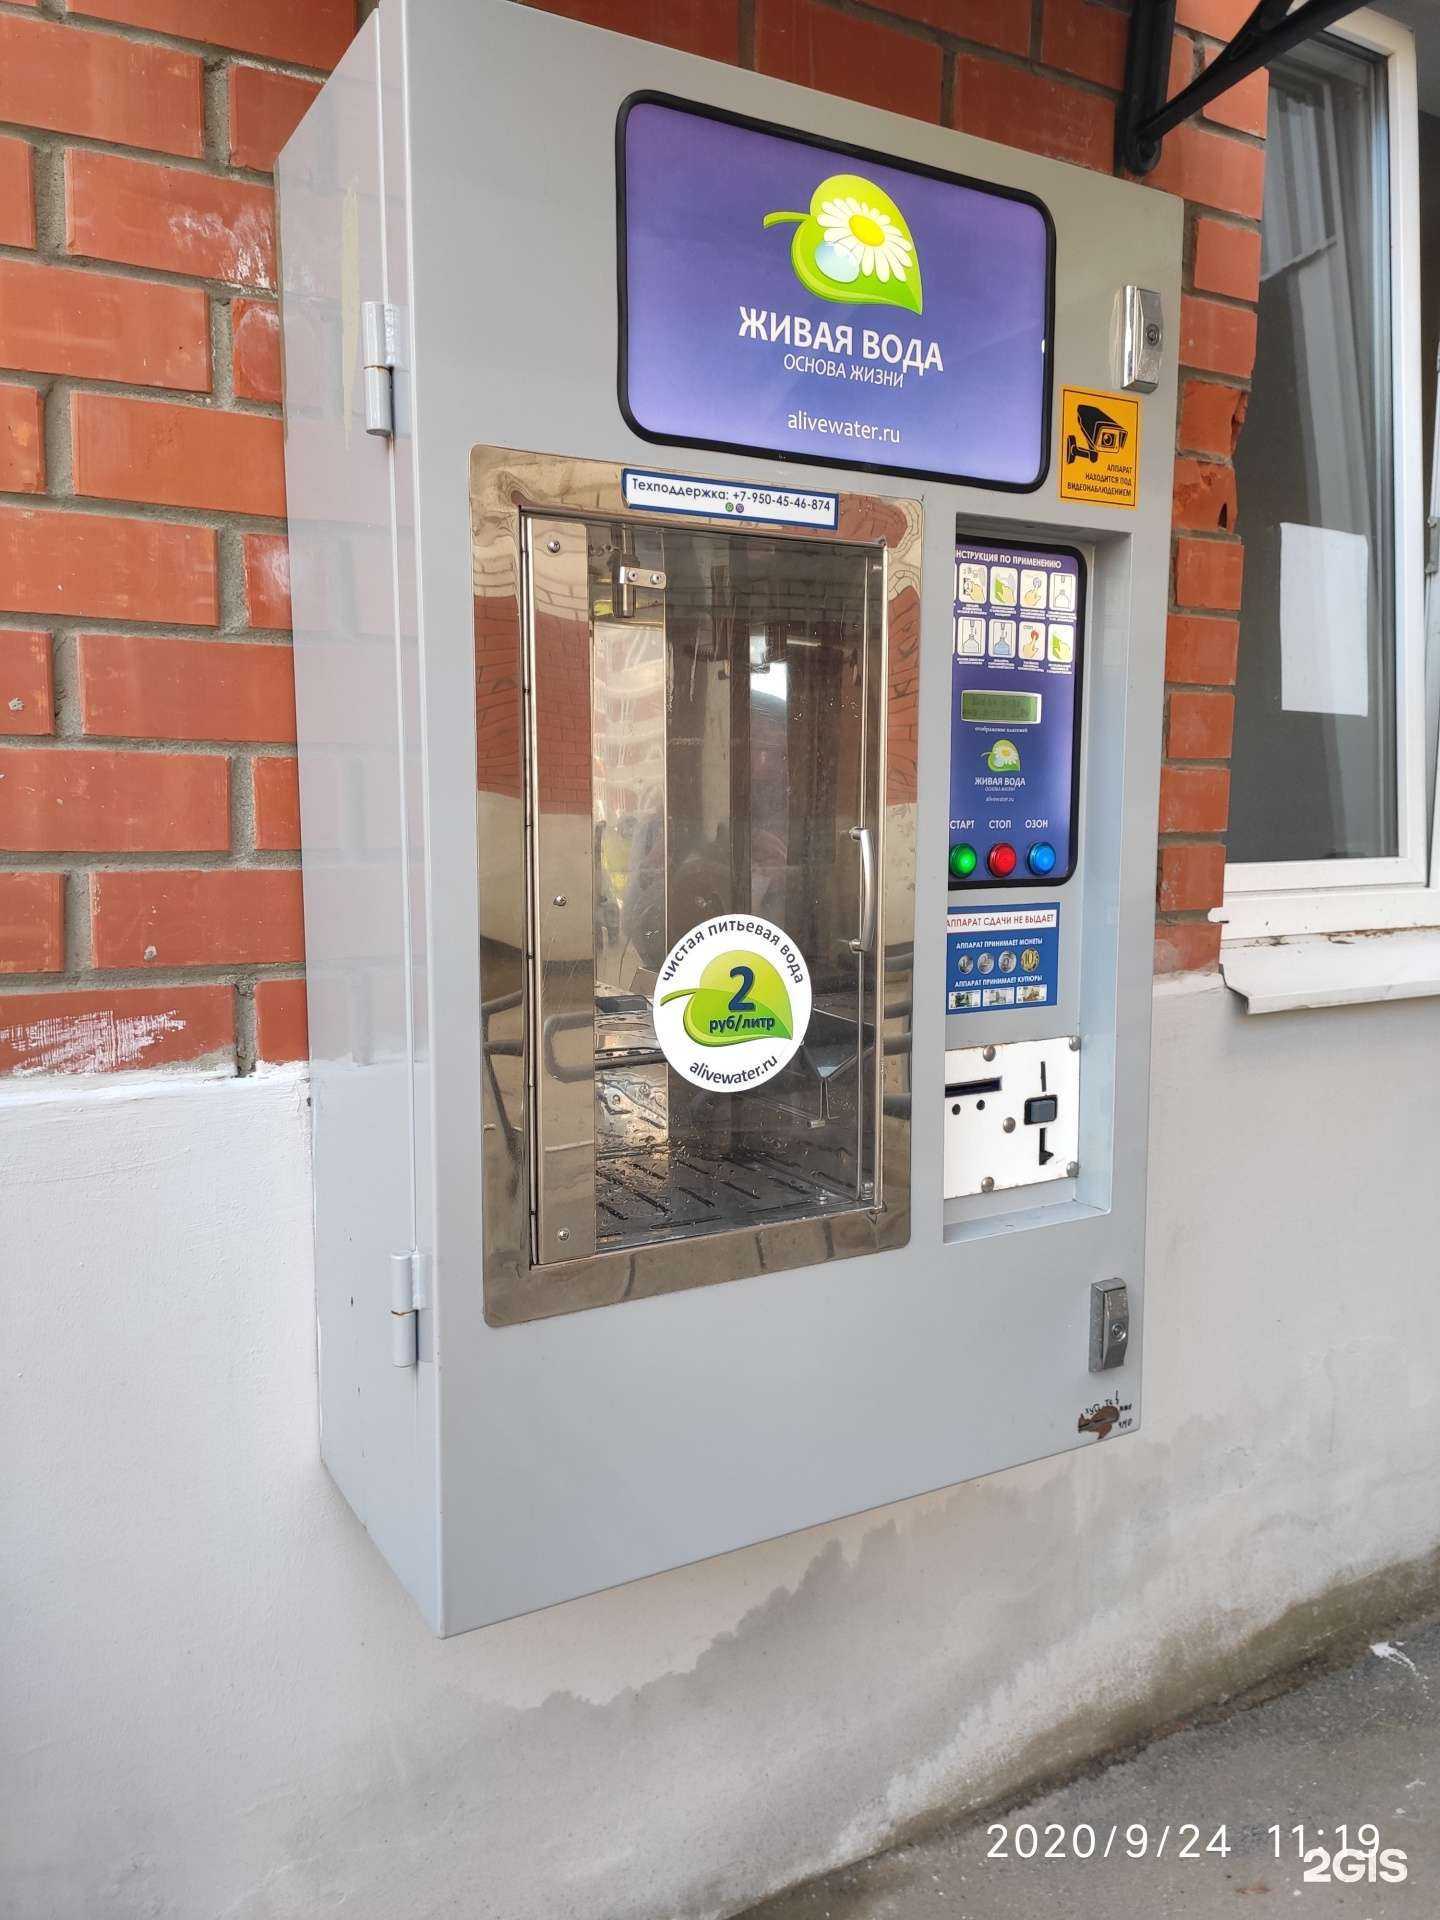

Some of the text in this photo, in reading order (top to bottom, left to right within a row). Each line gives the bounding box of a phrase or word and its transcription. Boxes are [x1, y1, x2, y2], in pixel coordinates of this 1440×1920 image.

[738, 305, 945, 376] ЖИВАЯ ВОДА
[783, 353, 904, 389] ОСНОВА ЖИЗНИ
[787, 410, 901, 444] alivewater.ru
[1107, 464, 1132, 474] АППАРАТ
[632, 478, 831, 512] Техподдержка: +7-950-45-46-874
[956, 550, 998, 562] НСТРУКЦИЯ
[1000, 554, 1011, 564] ПО
[974, 776, 1026, 788] ЖИВАЯ ВОДА
[949, 819, 975, 829] СТАРТ
[988, 819, 1012, 829] СТОП
[1025, 819, 1048, 829] ОЗОН
[983, 917, 1012, 927] СДАЧИ
[1014, 915, 1023, 924] НЕ
[1024, 914, 1054, 924] ВЫДАЕТ
[662, 920, 804, 984] чистая питьевая вода
[956, 941, 983, 950] АППАРАТ
[984, 939, 1018, 948] ПРИНИМАЕТ
[728, 965, 756, 1012] 2
[709, 1014, 775, 1033] руб/литр
[689, 1055, 778, 1085] alivewater.ru
